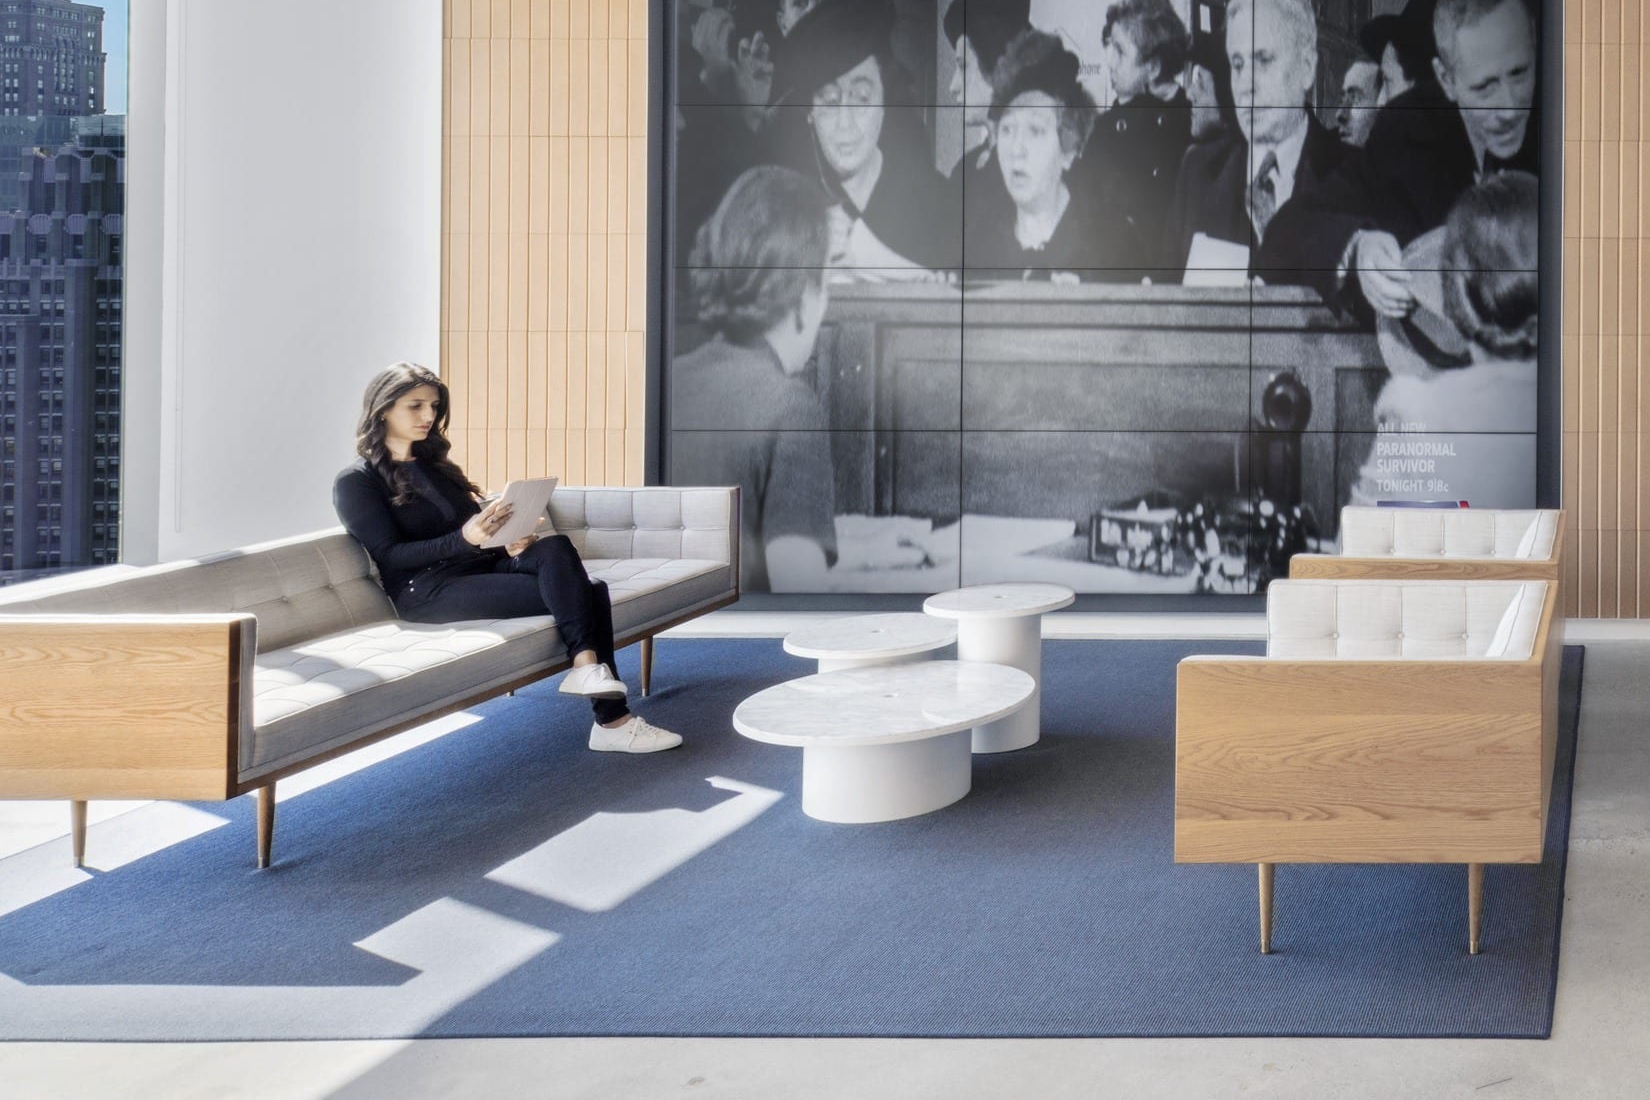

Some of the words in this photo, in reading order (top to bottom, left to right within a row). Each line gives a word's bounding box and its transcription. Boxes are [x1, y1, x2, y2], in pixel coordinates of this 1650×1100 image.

[1376, 442, 1457, 457] PARANORMAL
[1376, 459, 1436, 473] SURVIVOR
[1376, 479, 1425, 493] TONIGHT
